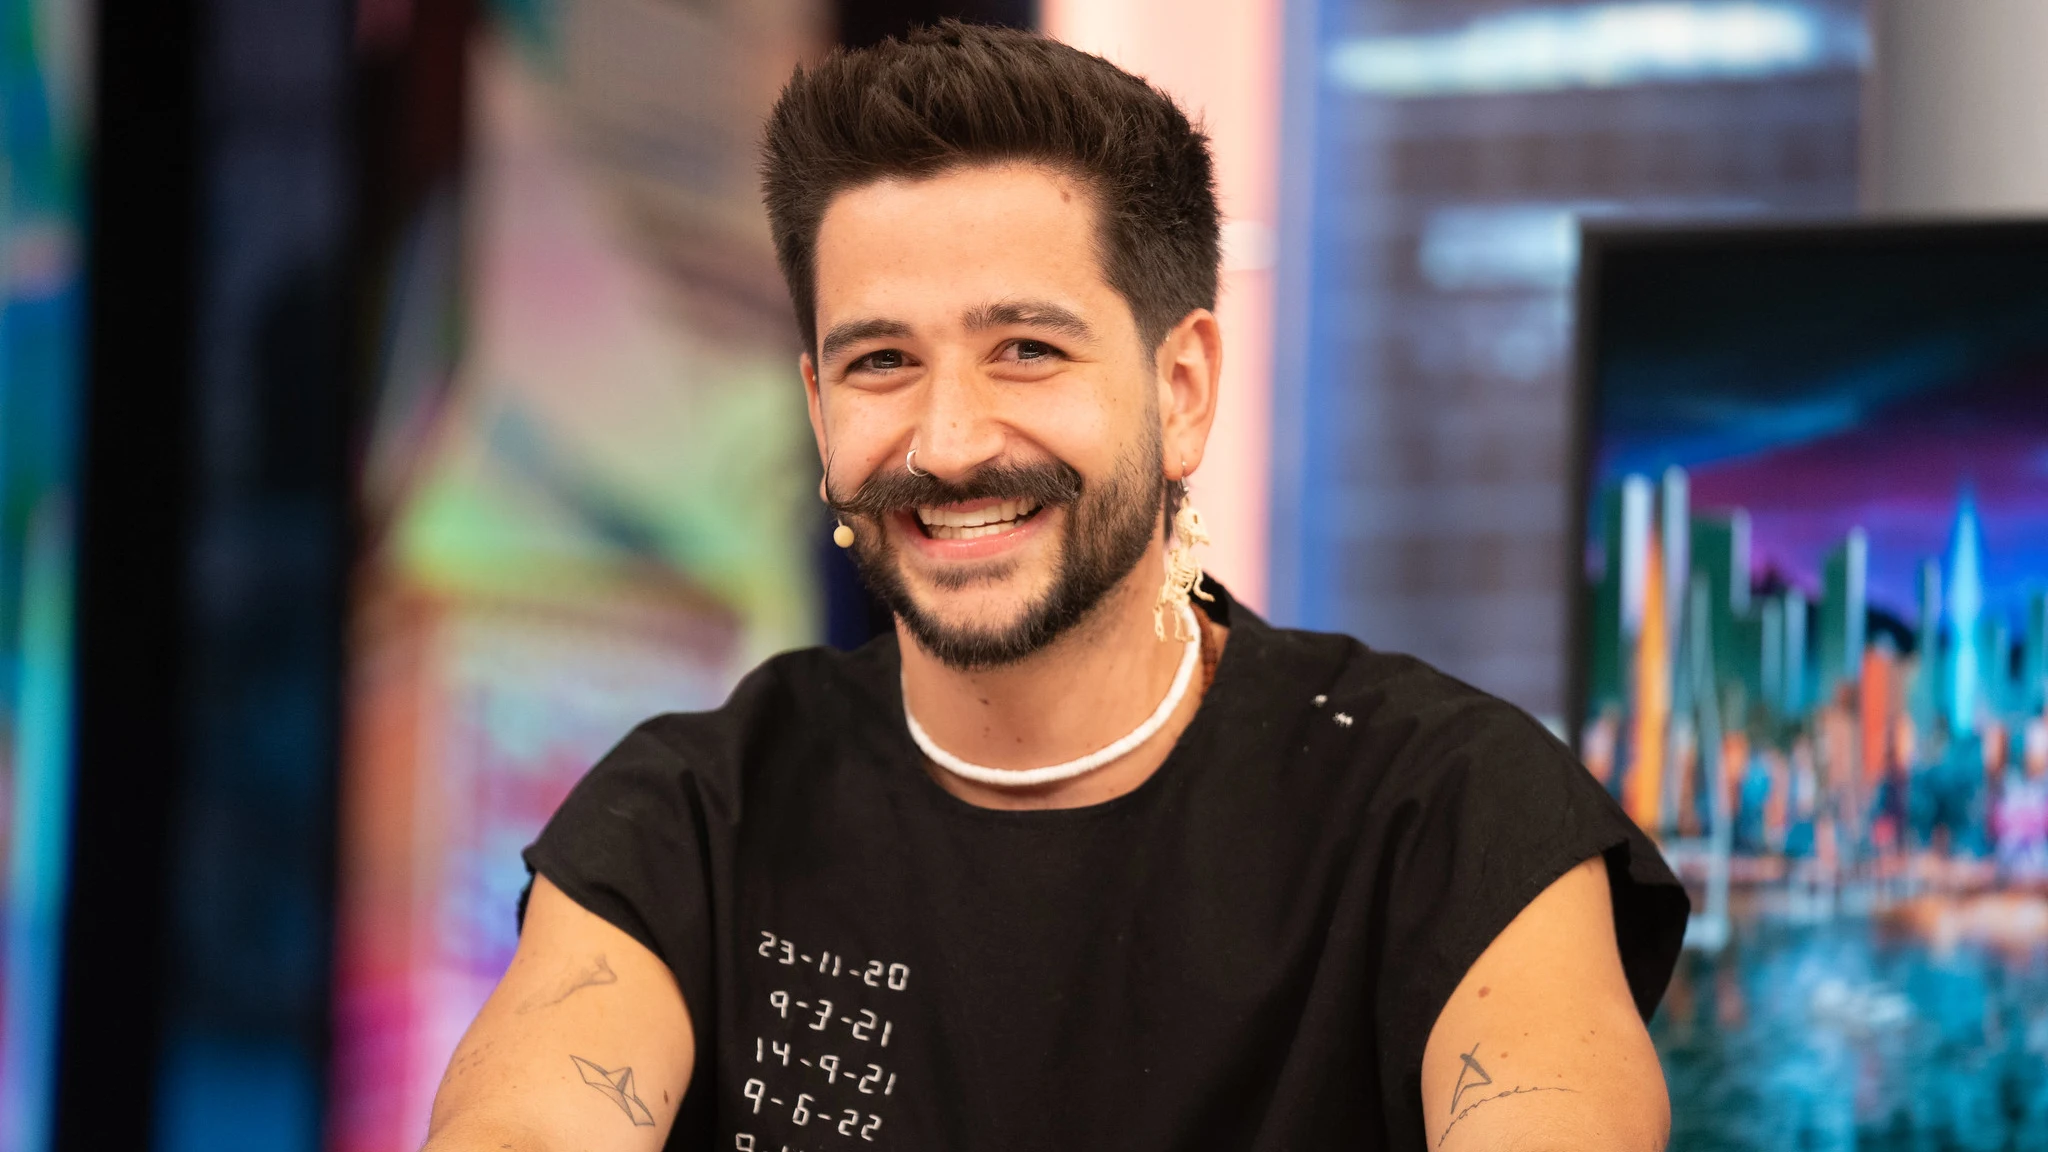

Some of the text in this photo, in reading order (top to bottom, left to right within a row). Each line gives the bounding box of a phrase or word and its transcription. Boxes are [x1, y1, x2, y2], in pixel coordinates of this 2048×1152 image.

[758, 930, 910, 991] 23-11-20
[770, 990, 893, 1047] 9-3-21
[756, 1036, 897, 1096] 14-9-21
[743, 1077, 883, 1142] 9-6-22
